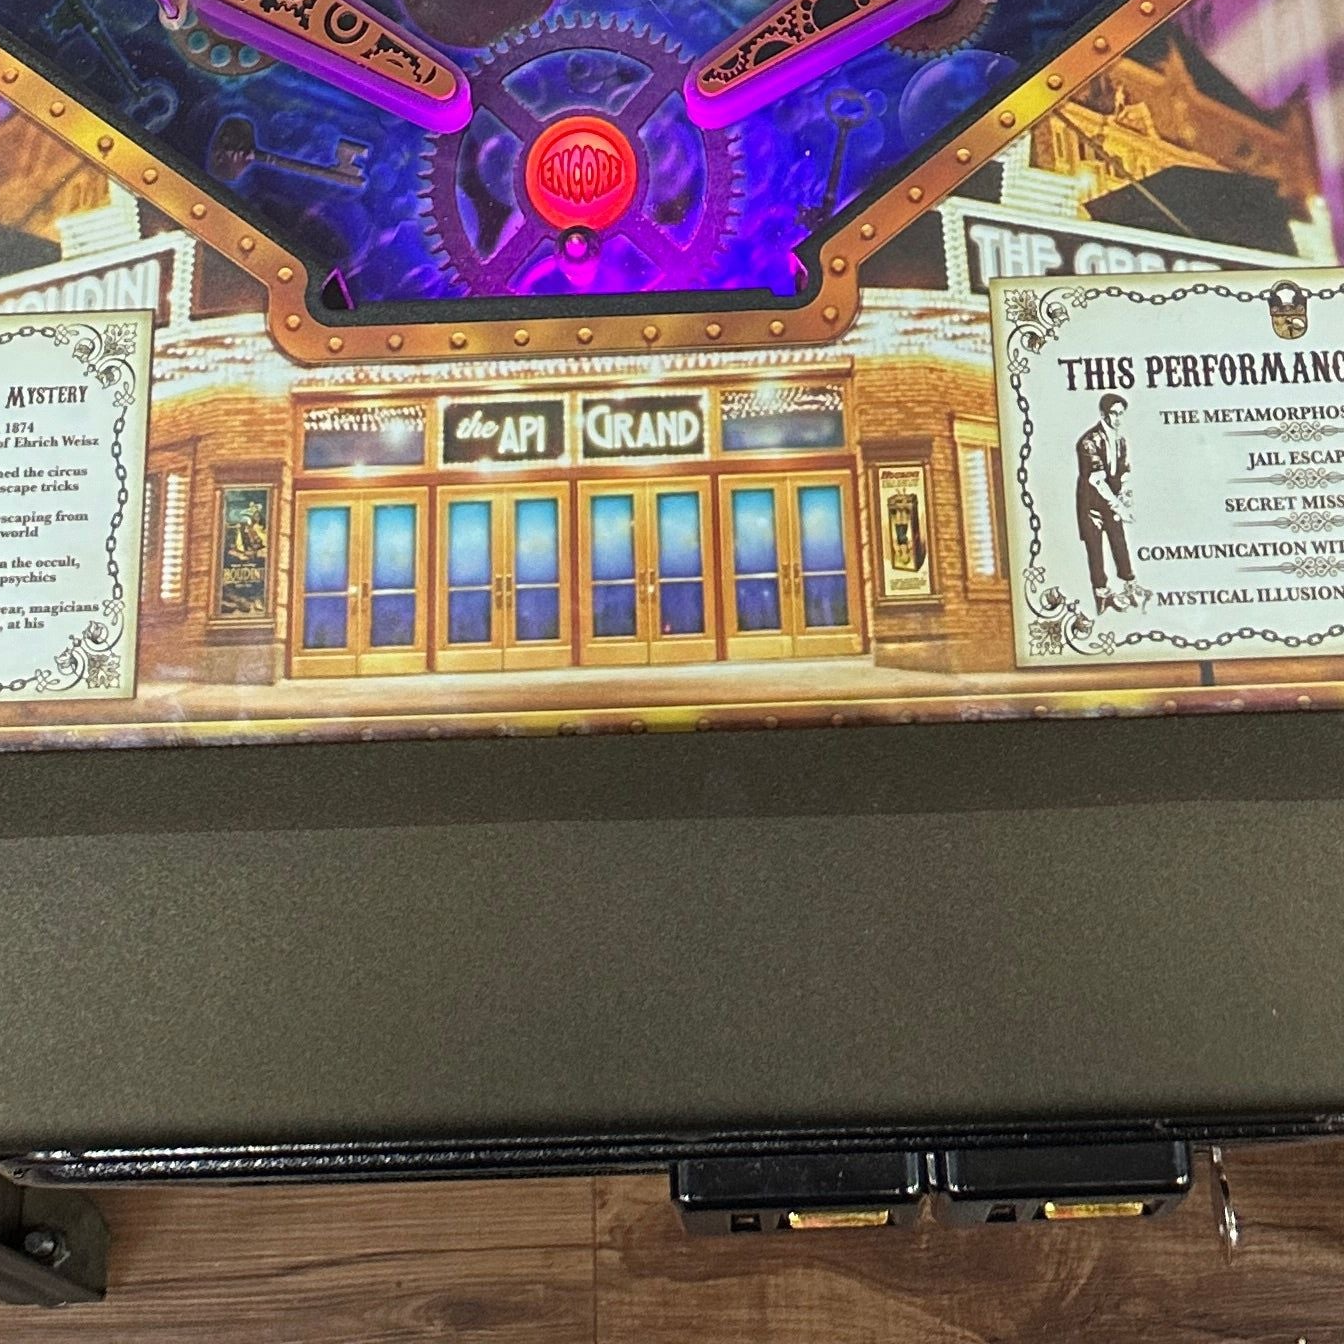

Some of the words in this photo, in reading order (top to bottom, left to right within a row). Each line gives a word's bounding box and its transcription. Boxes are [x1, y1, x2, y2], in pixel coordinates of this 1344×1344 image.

[540, 144, 624, 205] ENCORE
[1057, 356, 1135, 391] THIS
[3, 385, 88, 409] MYSTERY
[1159, 409, 1200, 425] THE
[5, 422, 34, 434] 1874
[454, 410, 499, 443] the
[497, 416, 546, 455] API
[584, 404, 703, 450] GRAND
[14, 437, 58, 448] Ehrich
[62, 436, 99, 447] Weisz
[1246, 453, 1285, 471] JAIL
[23, 467, 44, 478] the
[47, 466, 88, 478] circus
[41, 481, 79, 492] tricks
[1225, 496, 1297, 513] SECRET
[55, 511, 88, 522] from
[0, 526, 39, 542] world
[1136, 541, 1307, 561] COMMUNICATION
[11, 558, 33, 572] the
[35, 557, 80, 572] occult,
[0, 573, 56, 588] psychics
[1156, 589, 1254, 607] MYSTICAL
[29, 602, 100, 618] magicians
